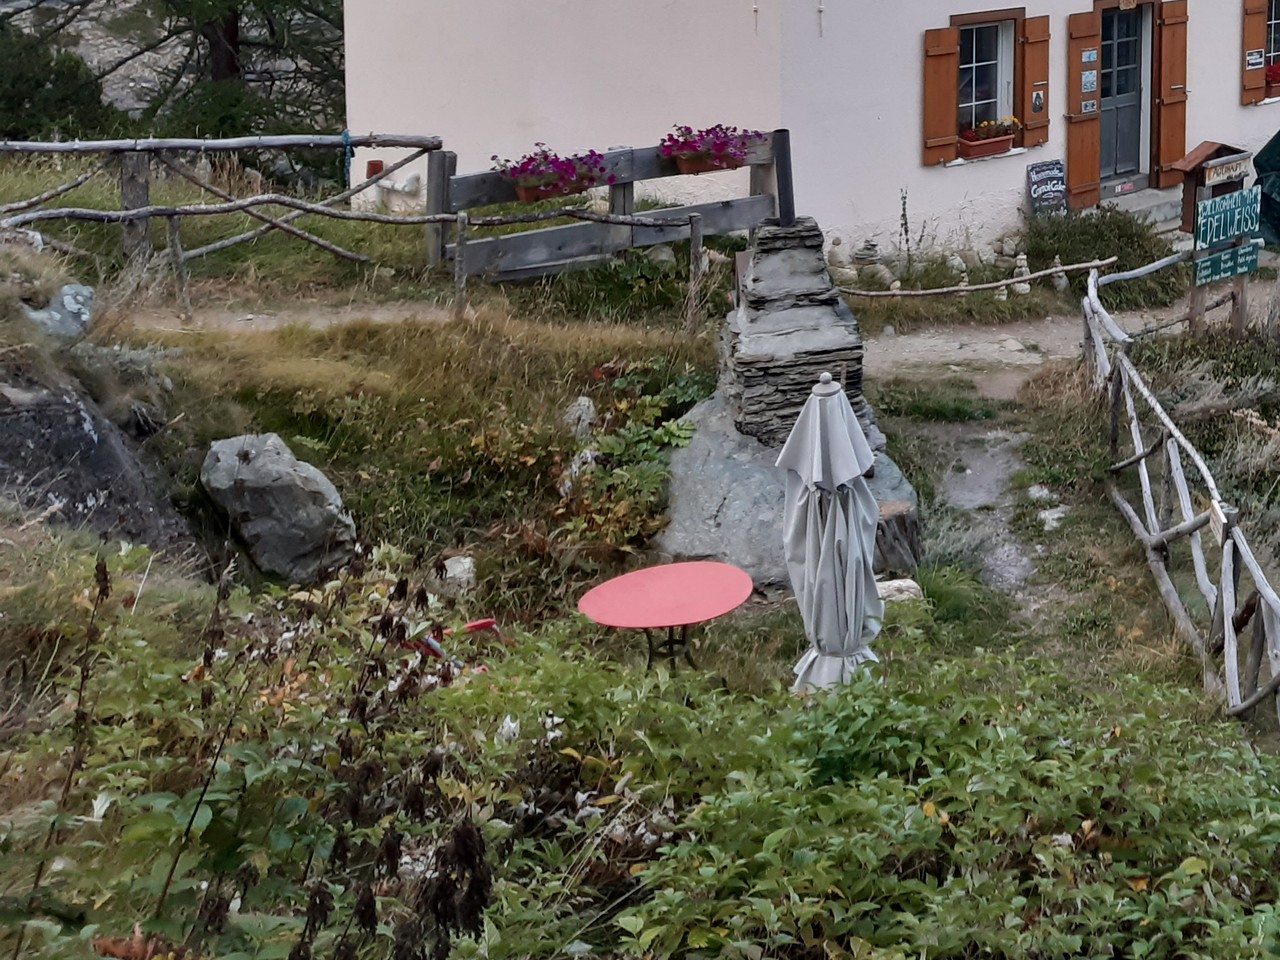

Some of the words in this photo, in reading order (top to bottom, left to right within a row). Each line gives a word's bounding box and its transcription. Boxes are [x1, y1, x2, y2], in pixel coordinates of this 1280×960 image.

[1031, 181, 1051, 198] Carrot
[1051, 180, 1066, 191] Cake
[1201, 193, 1241, 216] WILLKOMMEN
[1200, 203, 1257, 246] EDELWEISS
